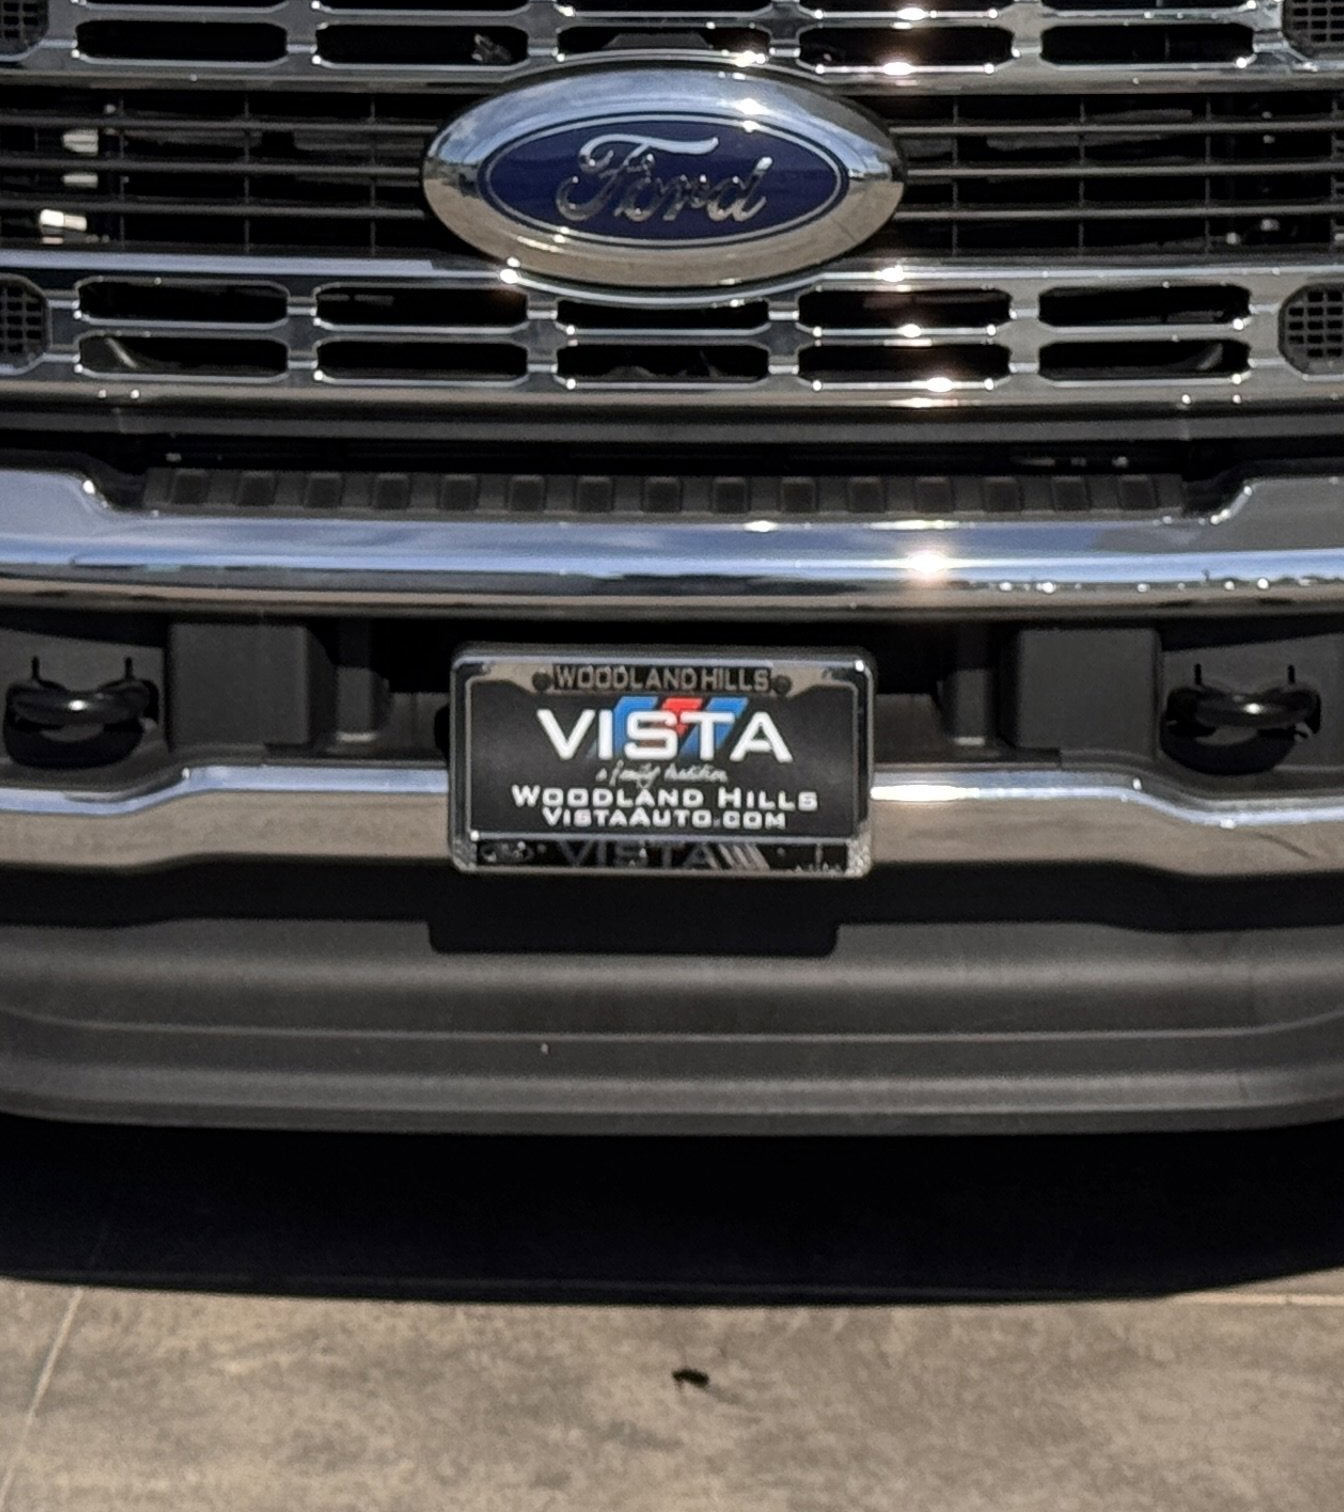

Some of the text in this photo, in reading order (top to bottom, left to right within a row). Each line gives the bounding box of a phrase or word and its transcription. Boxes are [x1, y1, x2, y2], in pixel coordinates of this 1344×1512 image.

[557, 134, 773, 222] Ford
[557, 665, 770, 692] WOODLAND HILLS
[537, 708, 794, 764] VISTA
[512, 784, 819, 811] WOODLAND HILLS
